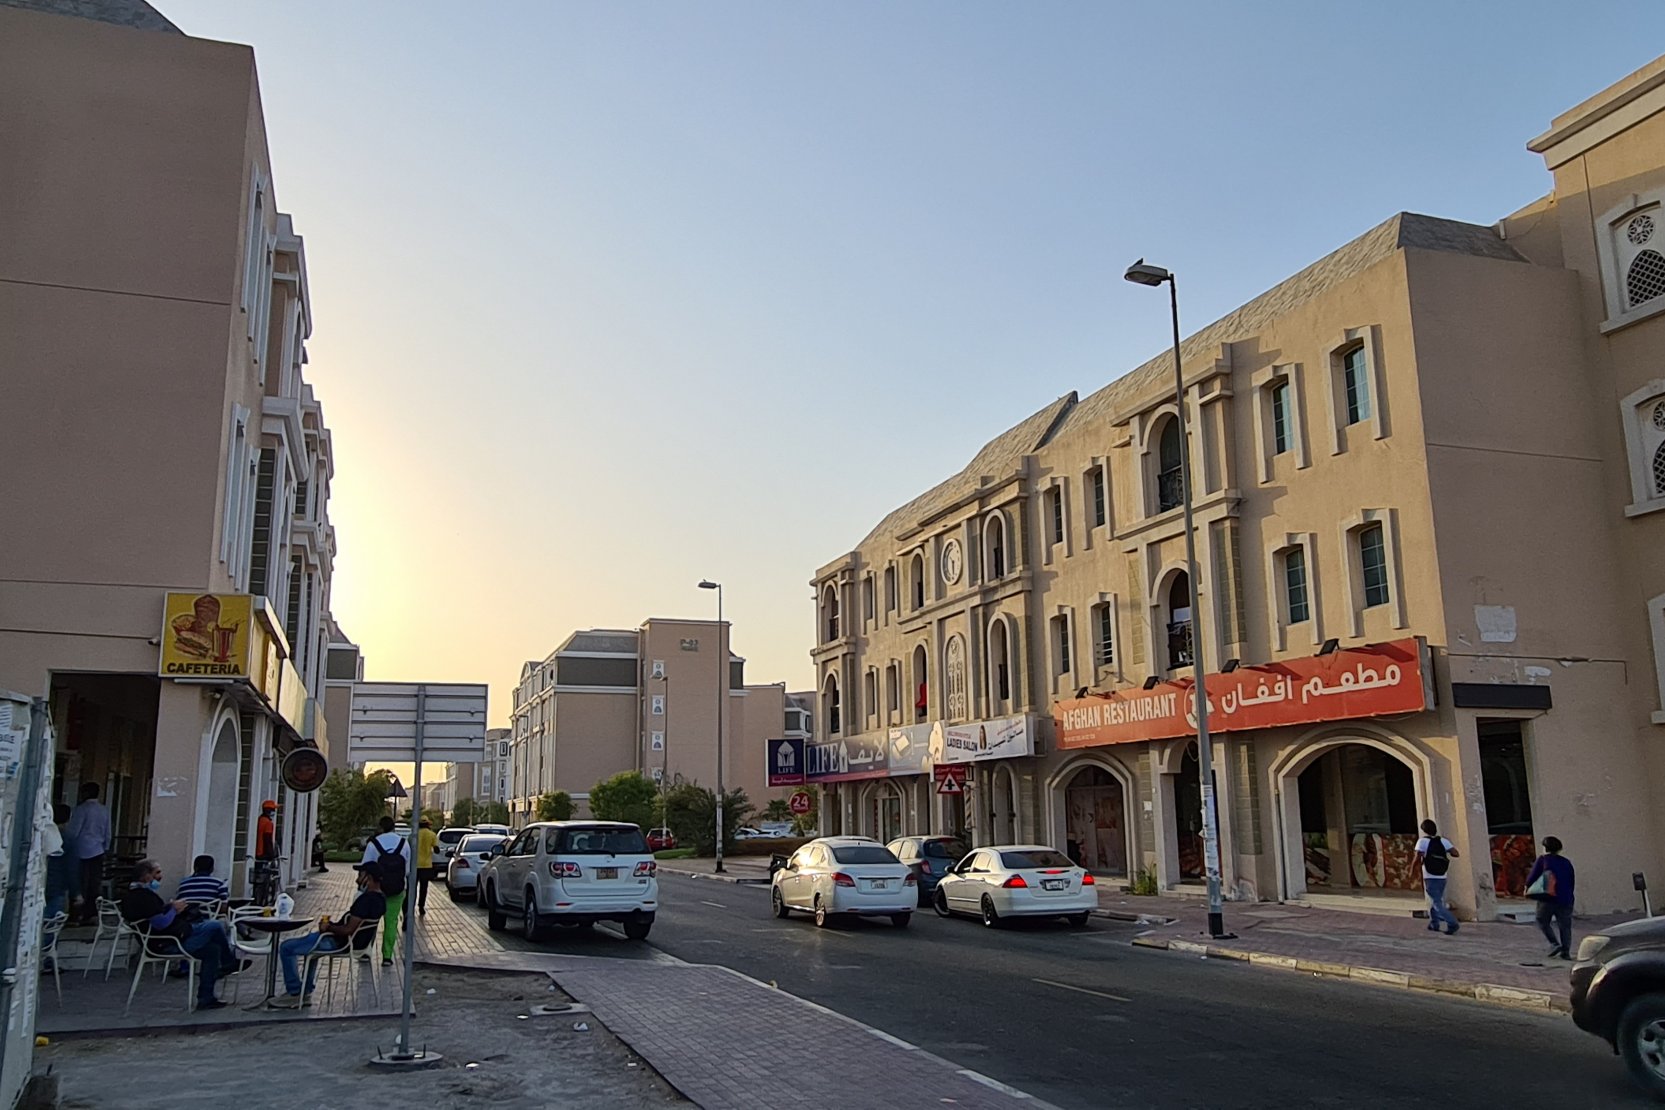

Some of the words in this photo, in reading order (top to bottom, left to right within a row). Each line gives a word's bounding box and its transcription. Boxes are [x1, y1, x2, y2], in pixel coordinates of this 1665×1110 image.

[166, 662, 241, 675] CAFETERIA
[1302, 663, 1401, 704] مطعم
[1063, 706, 1101, 731] AFGHAN
[1104, 693, 1177, 725] RESTAURANT
[807, 743, 839, 774] LIFE
[793, 795, 809, 808] 24
